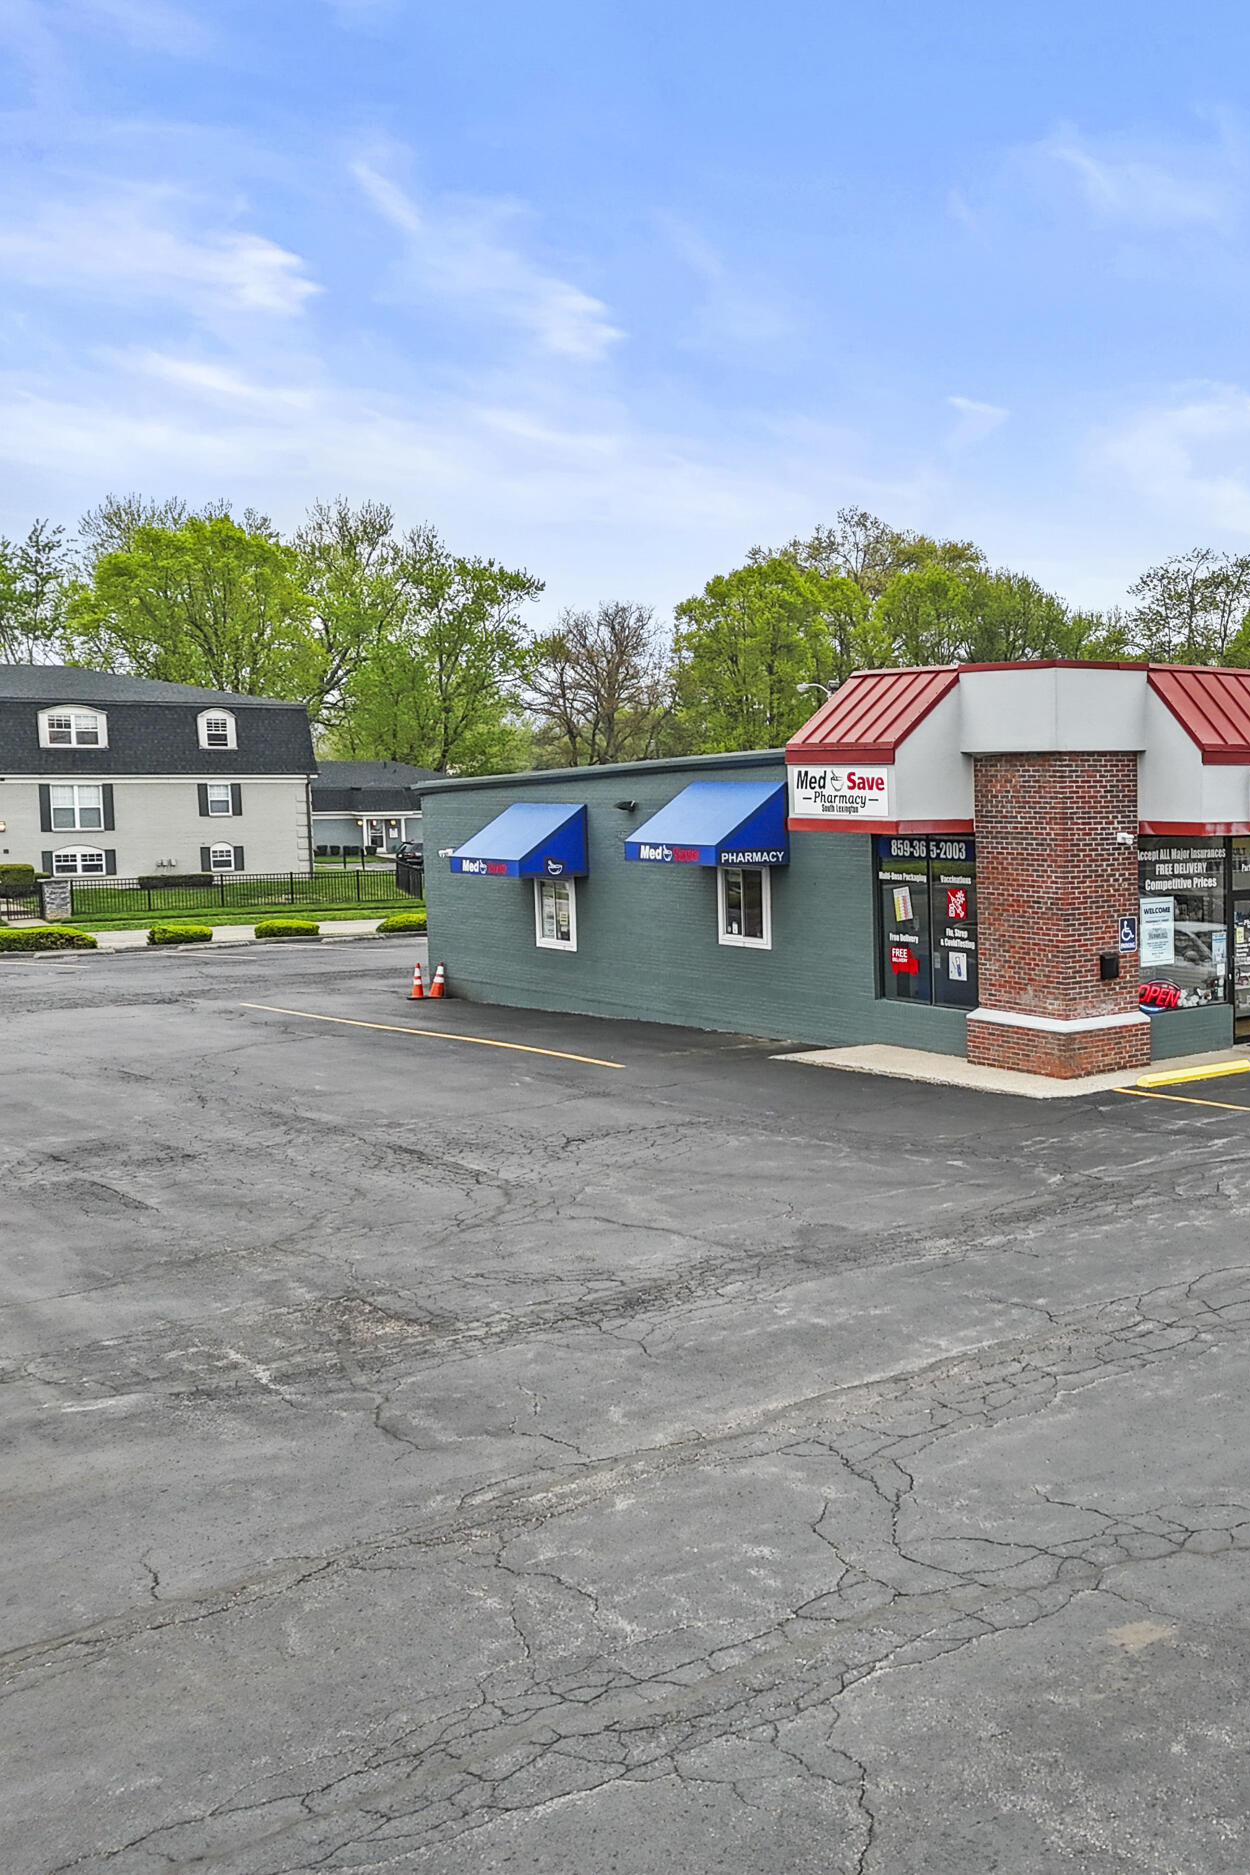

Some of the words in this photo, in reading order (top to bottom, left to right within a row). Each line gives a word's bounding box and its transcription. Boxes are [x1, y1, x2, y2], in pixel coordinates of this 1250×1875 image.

[796, 770, 827, 790] Med
[847, 772, 885, 791] Save
[813, 791, 867, 808] Pharmacy
[640, 845, 661, 860] Med
[721, 851, 785, 864] PHARMACY
[1160, 849, 1170, 860] ALL
[1171, 848, 1189, 860] Major
[1191, 847, 1226, 858] Insurances
[462, 859, 479, 873] Med
[1155, 863, 1173, 875] FREE
[1174, 862, 1207, 874] DELIVERY
[1145, 878, 1192, 891] Competitive
[1193, 877, 1217, 888] Prices
[1144, 907, 1170, 915] WELCOME
[892, 948, 908, 958] FREE
[1138, 984, 1180, 1008] OPEN
